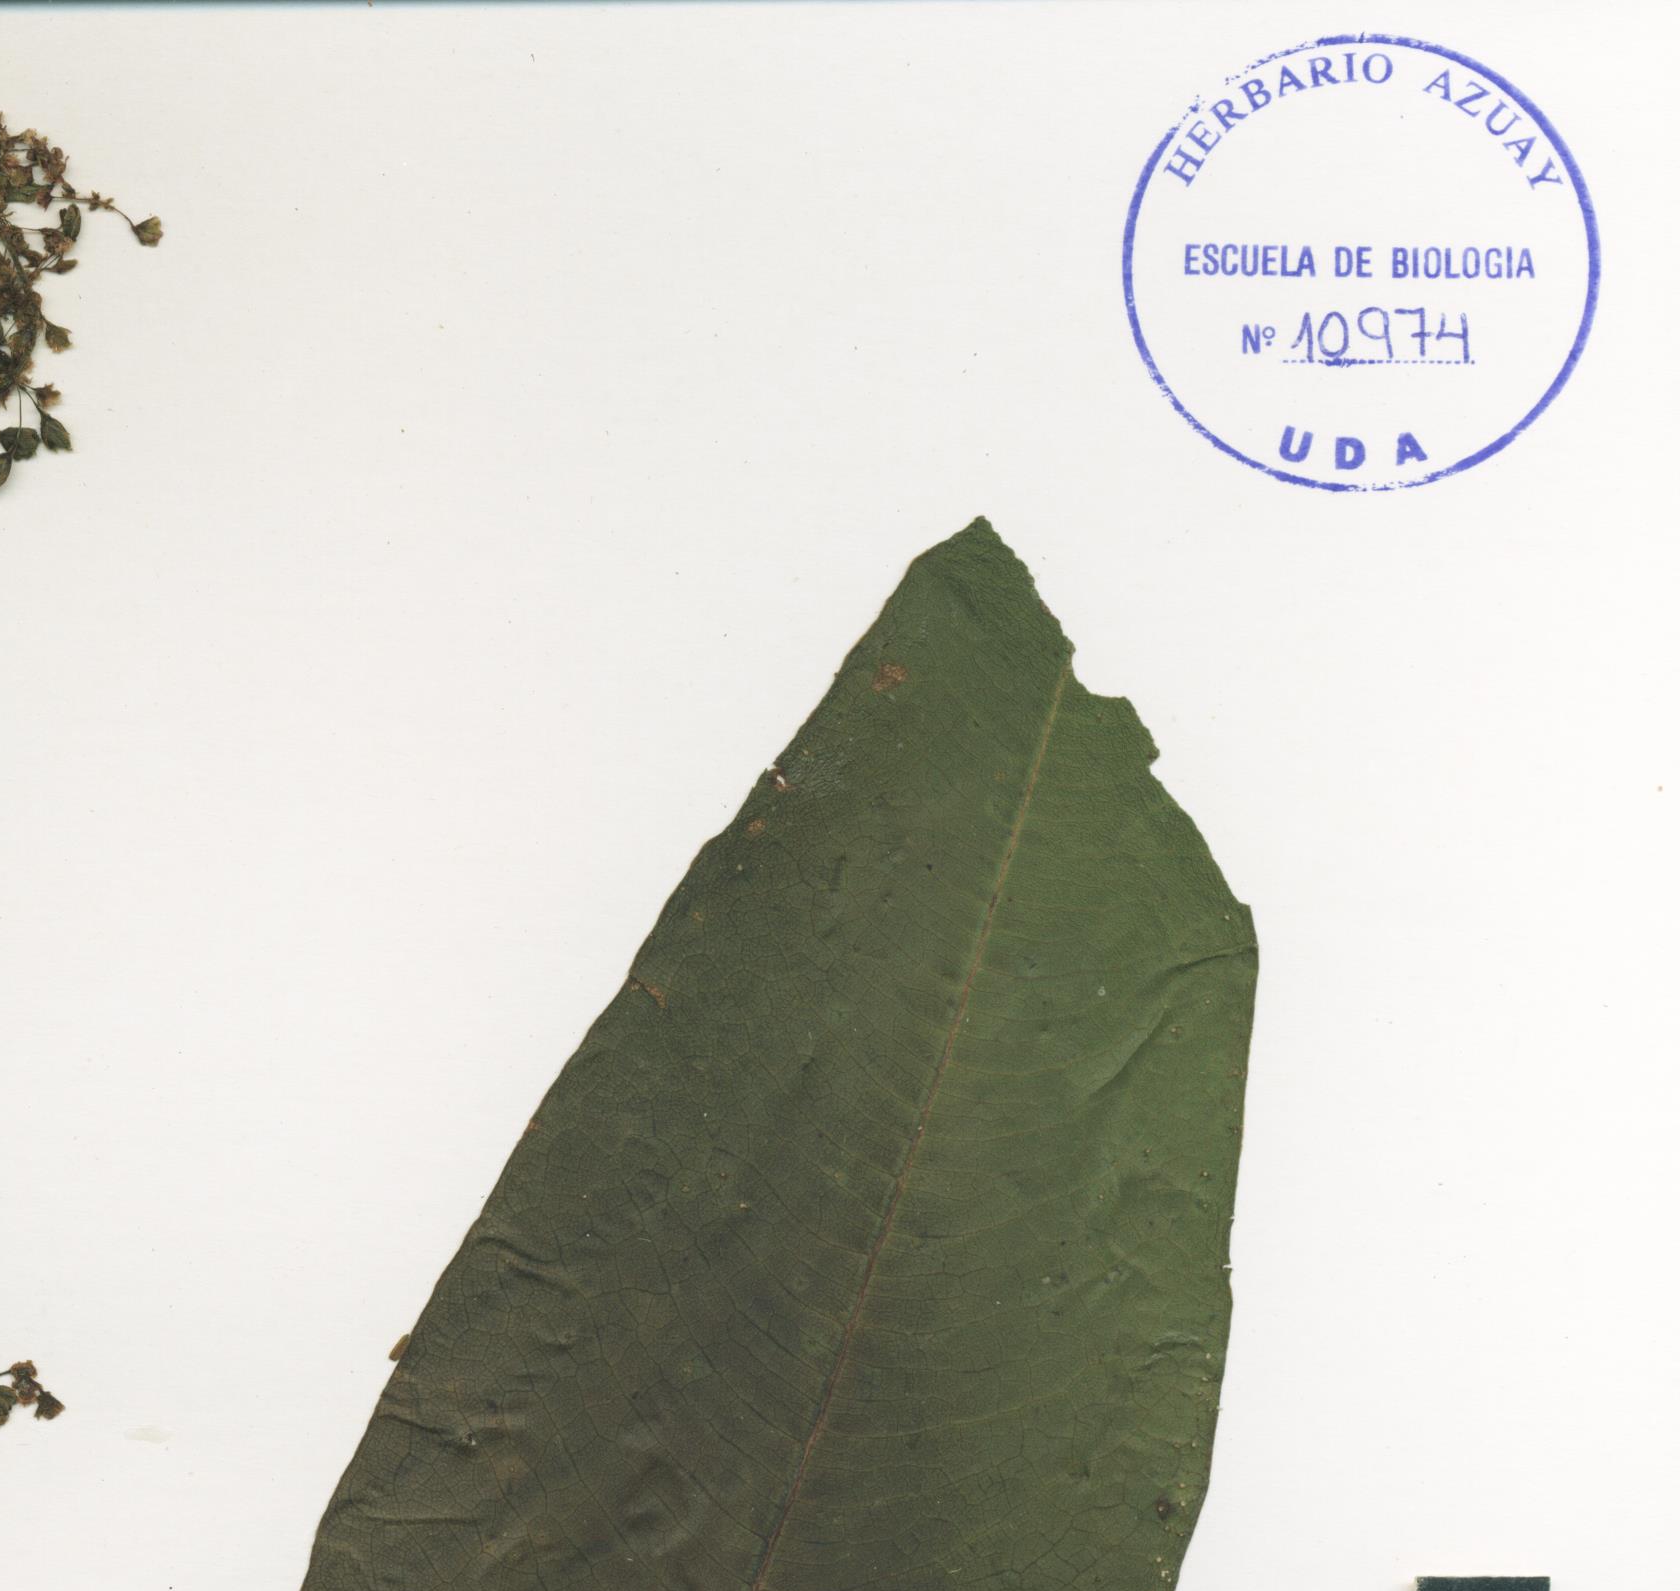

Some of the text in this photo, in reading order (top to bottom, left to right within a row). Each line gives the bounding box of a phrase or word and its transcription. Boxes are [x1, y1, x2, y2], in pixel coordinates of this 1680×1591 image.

[1163, 52, 1564, 190] HERBARIO AZUAY
[1184, 243, 1536, 279] ESCUELA DE BIOLOGIA
[1291, 306, 1470, 364] 10974
